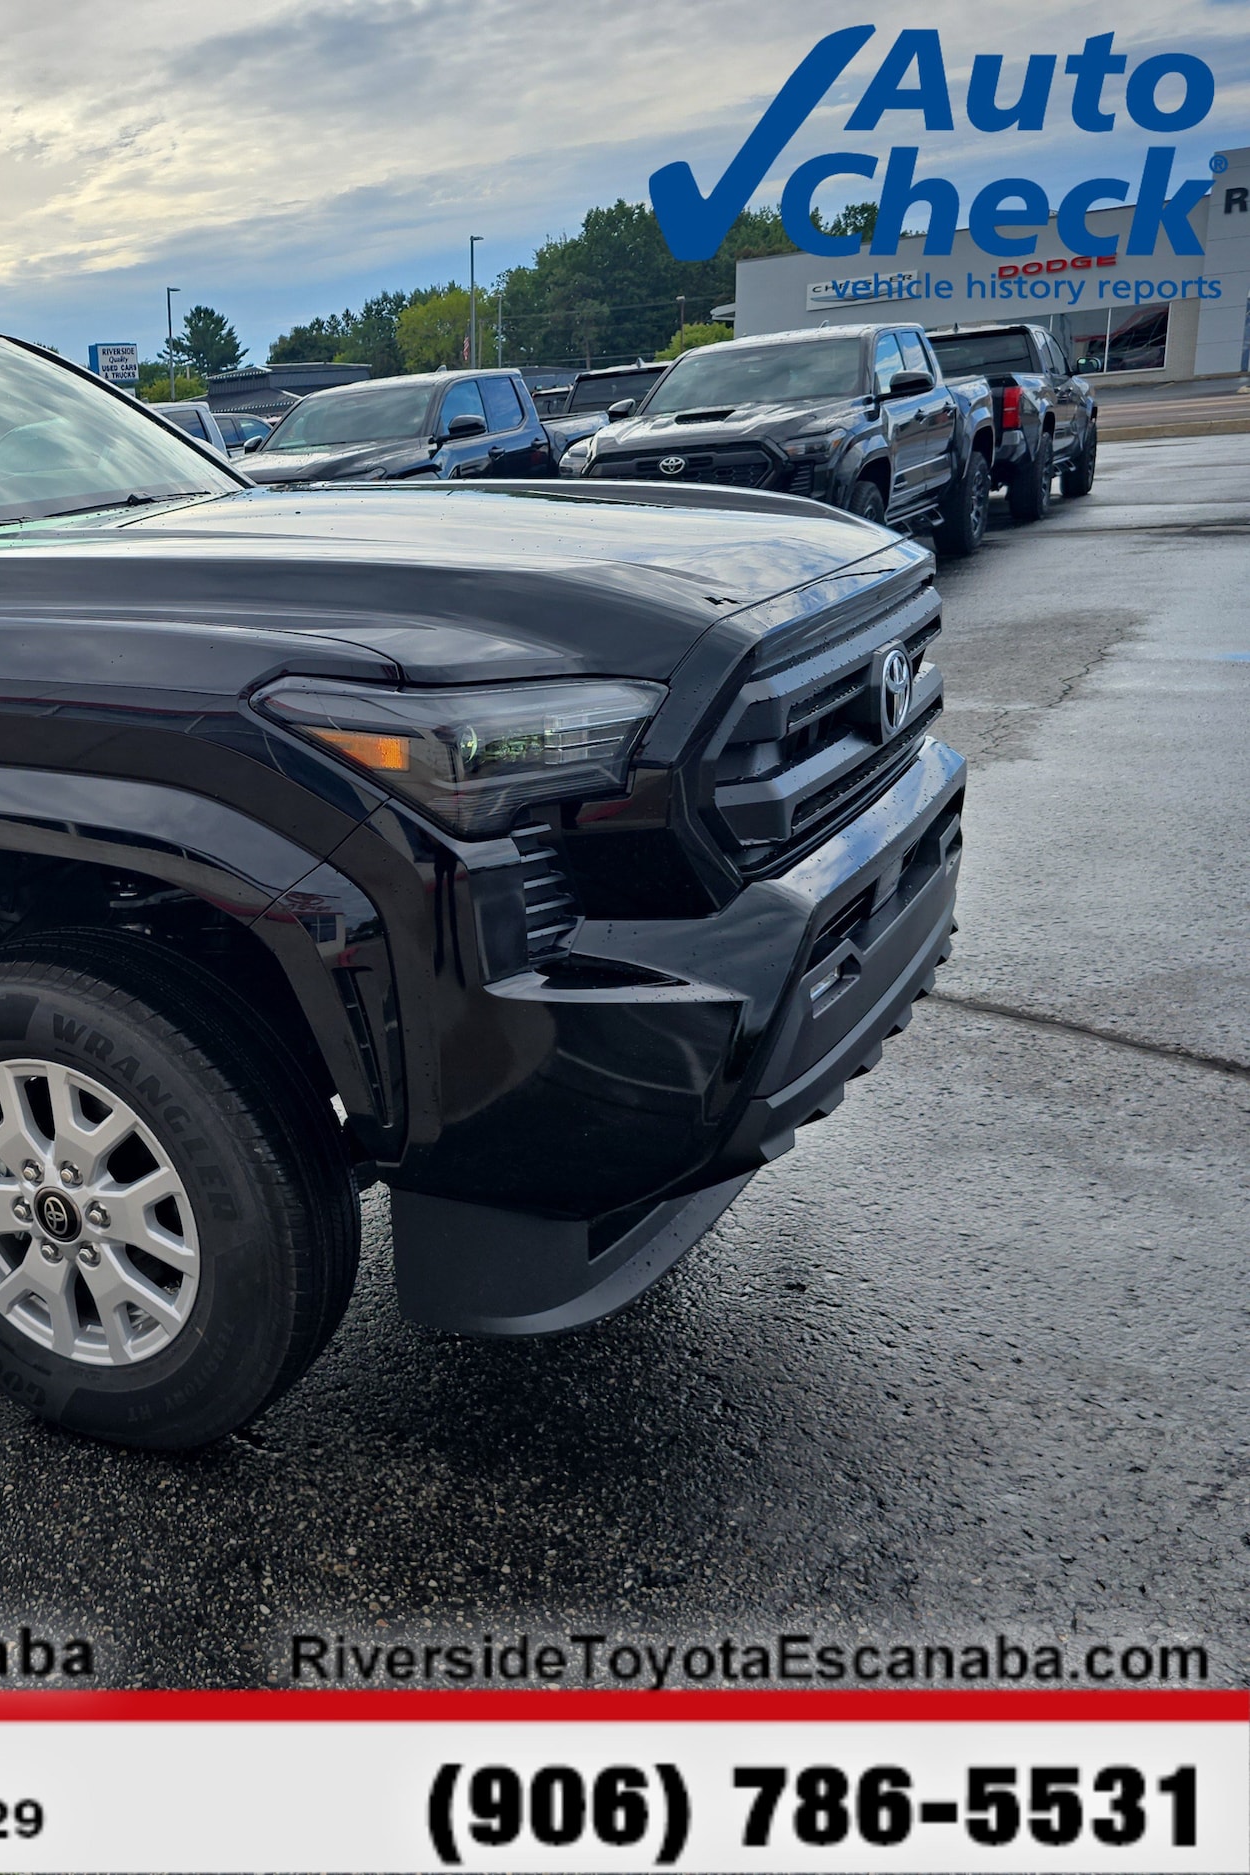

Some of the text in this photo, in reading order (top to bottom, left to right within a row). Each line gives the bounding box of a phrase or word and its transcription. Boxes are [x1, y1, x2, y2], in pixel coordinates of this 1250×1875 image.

[998, 254, 1117, 279] DODGE
[102, 347, 135, 355] RIVERSIDE
[109, 355, 129, 364] Quality
[102, 364, 118, 372] USED
[111, 371, 136, 379] TRUCKS
[52, 1012, 241, 1222] WRANGLER
